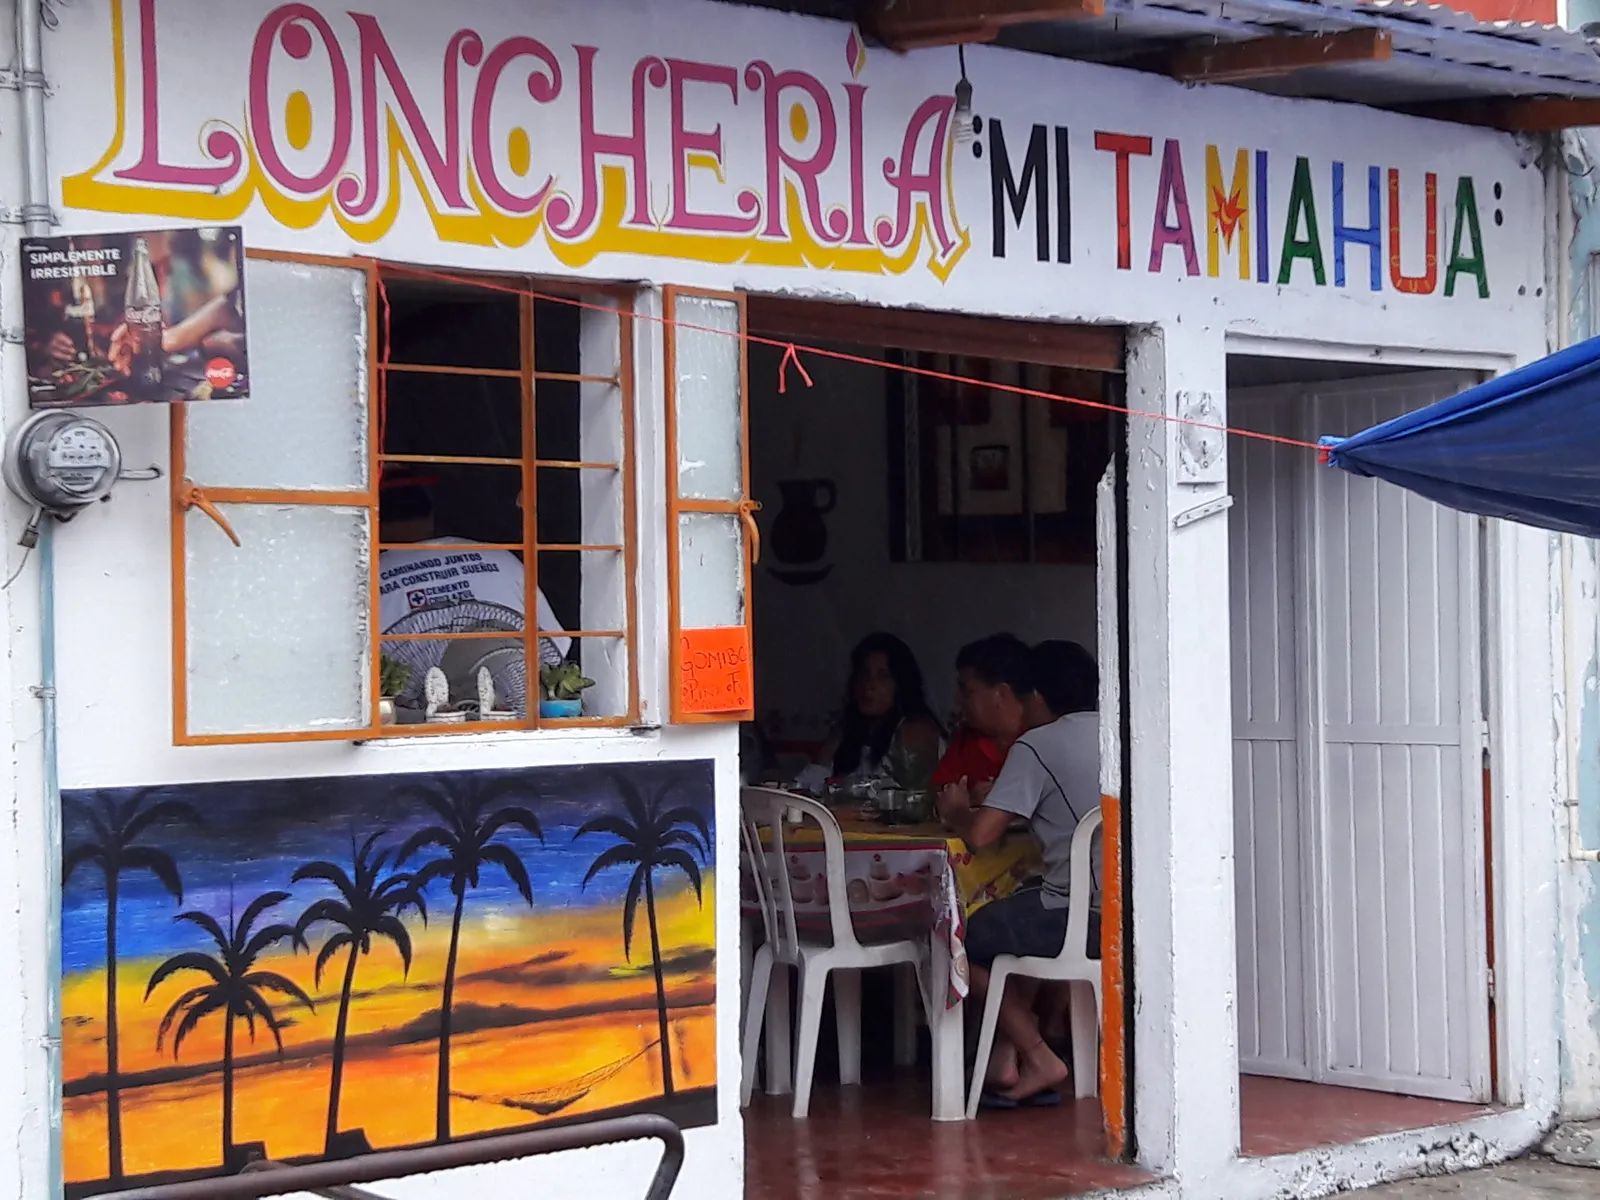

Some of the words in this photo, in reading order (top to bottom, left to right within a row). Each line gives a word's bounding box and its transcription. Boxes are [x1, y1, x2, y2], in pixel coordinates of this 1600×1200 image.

[29, 248, 121, 265] SIMPLEMENTE
[30, 263, 117, 279] IRRESISTIBLE
[380, 558, 441, 580] CAMINANDO
[444, 552, 482, 565] JUNTOS
[379, 581, 400, 596] ARA
[401, 567, 459, 587] CONSTRUIR
[426, 580, 470, 595] CEMENTO
